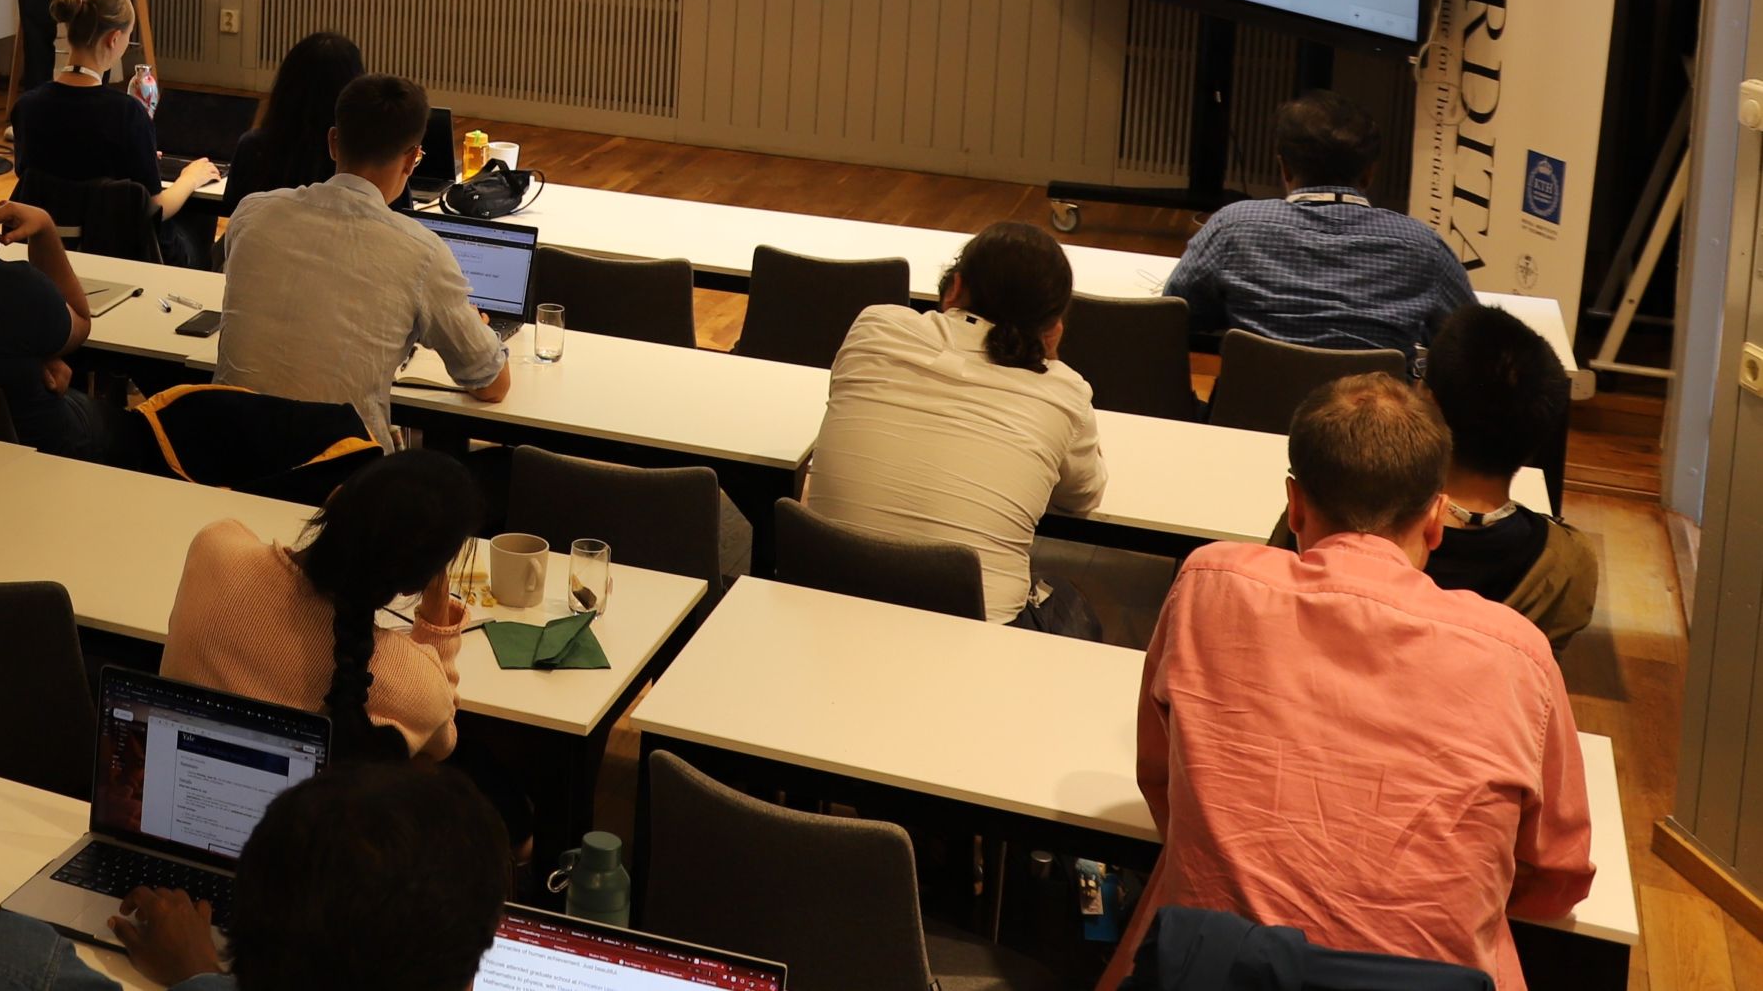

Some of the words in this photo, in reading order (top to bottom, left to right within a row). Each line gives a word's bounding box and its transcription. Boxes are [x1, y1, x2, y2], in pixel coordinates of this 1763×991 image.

[1438, 44, 1454, 77] for
[1430, 86, 1450, 200] Theoretical
[1533, 177, 1555, 195] KTH
